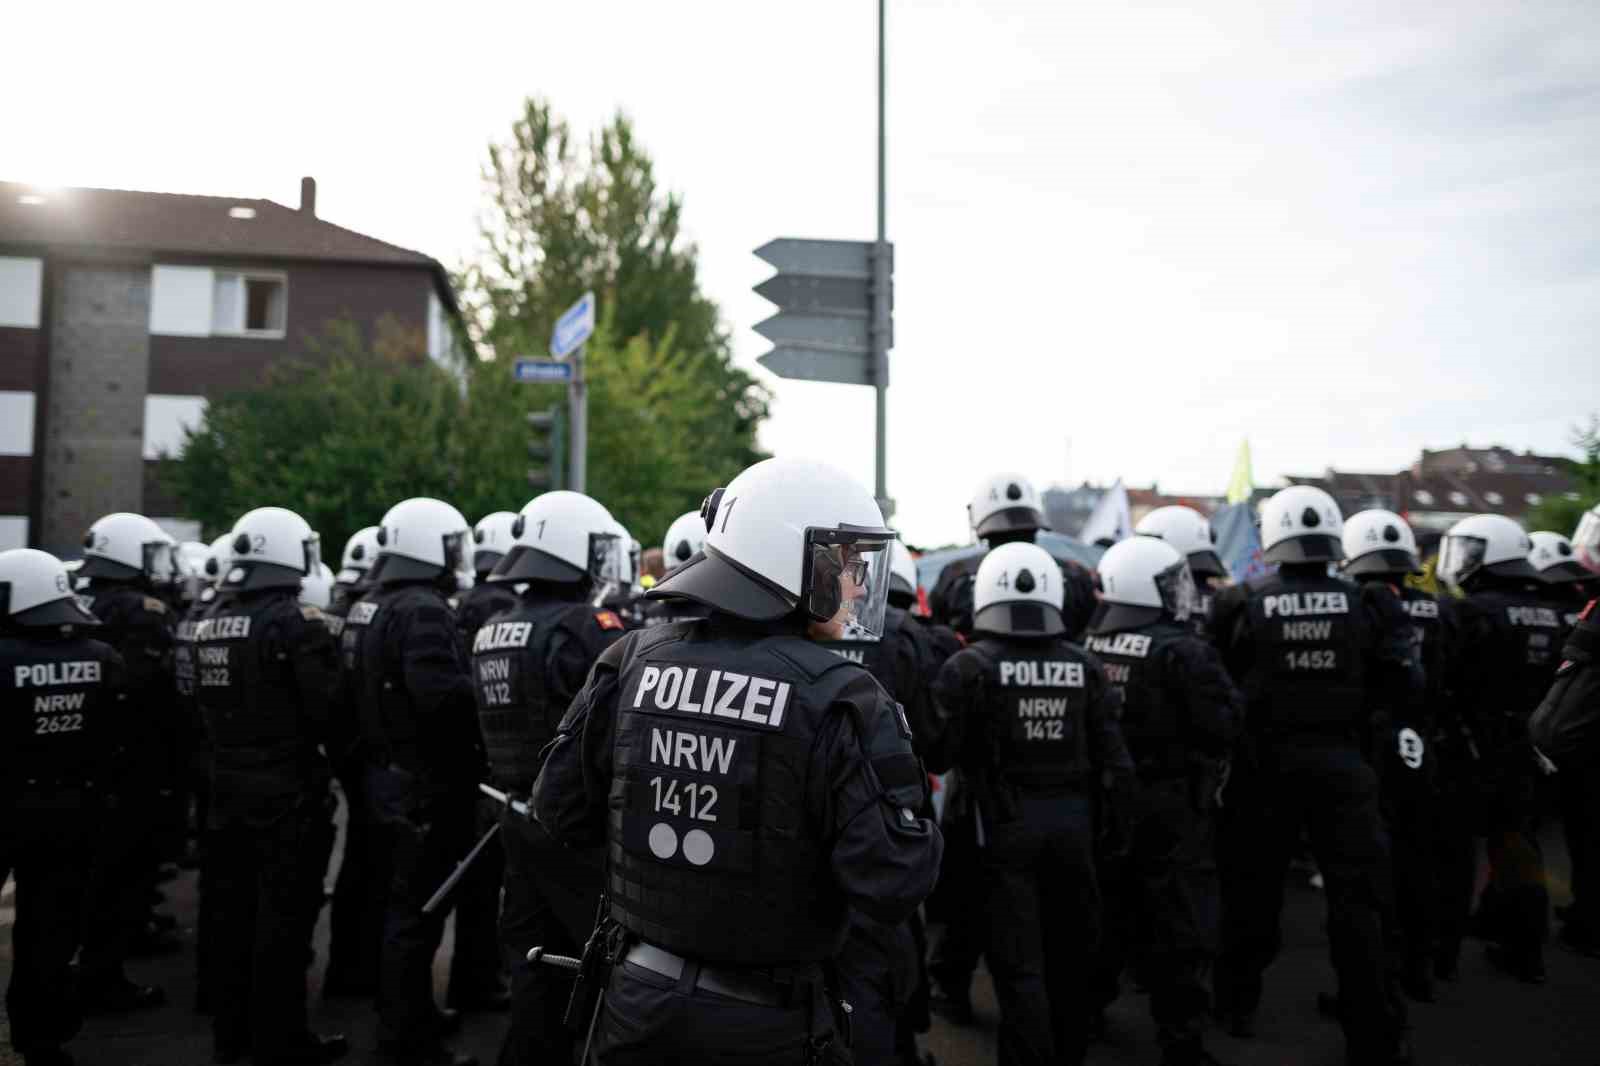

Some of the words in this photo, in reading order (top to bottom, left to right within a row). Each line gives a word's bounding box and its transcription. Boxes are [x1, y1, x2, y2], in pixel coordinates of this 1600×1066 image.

[720, 496, 737, 533] 1
[534, 519, 546, 540] 1
[97, 536, 109, 551] 2
[253, 534, 266, 554] 2
[997, 571, 1008, 592] 4
[1040, 573, 1047, 592] 1
[1263, 592, 1349, 618] POLIZEI
[1283, 621, 1332, 641] NRW
[480, 657, 510, 681] NRW
[1284, 650, 1336, 670] 1452
[15, 660, 101, 688] POLIZEI
[1000, 661, 1084, 688] POLIZEI
[34, 692, 85, 713] NRW
[483, 682, 512, 705] 1412
[633, 665, 792, 727] POLIZEI
[1018, 697, 1068, 718] NRW
[35, 714, 83, 735] 2622
[1023, 720, 1064, 741] 1412
[650, 727, 736, 775] NRW
[649, 776, 718, 823] 1412
